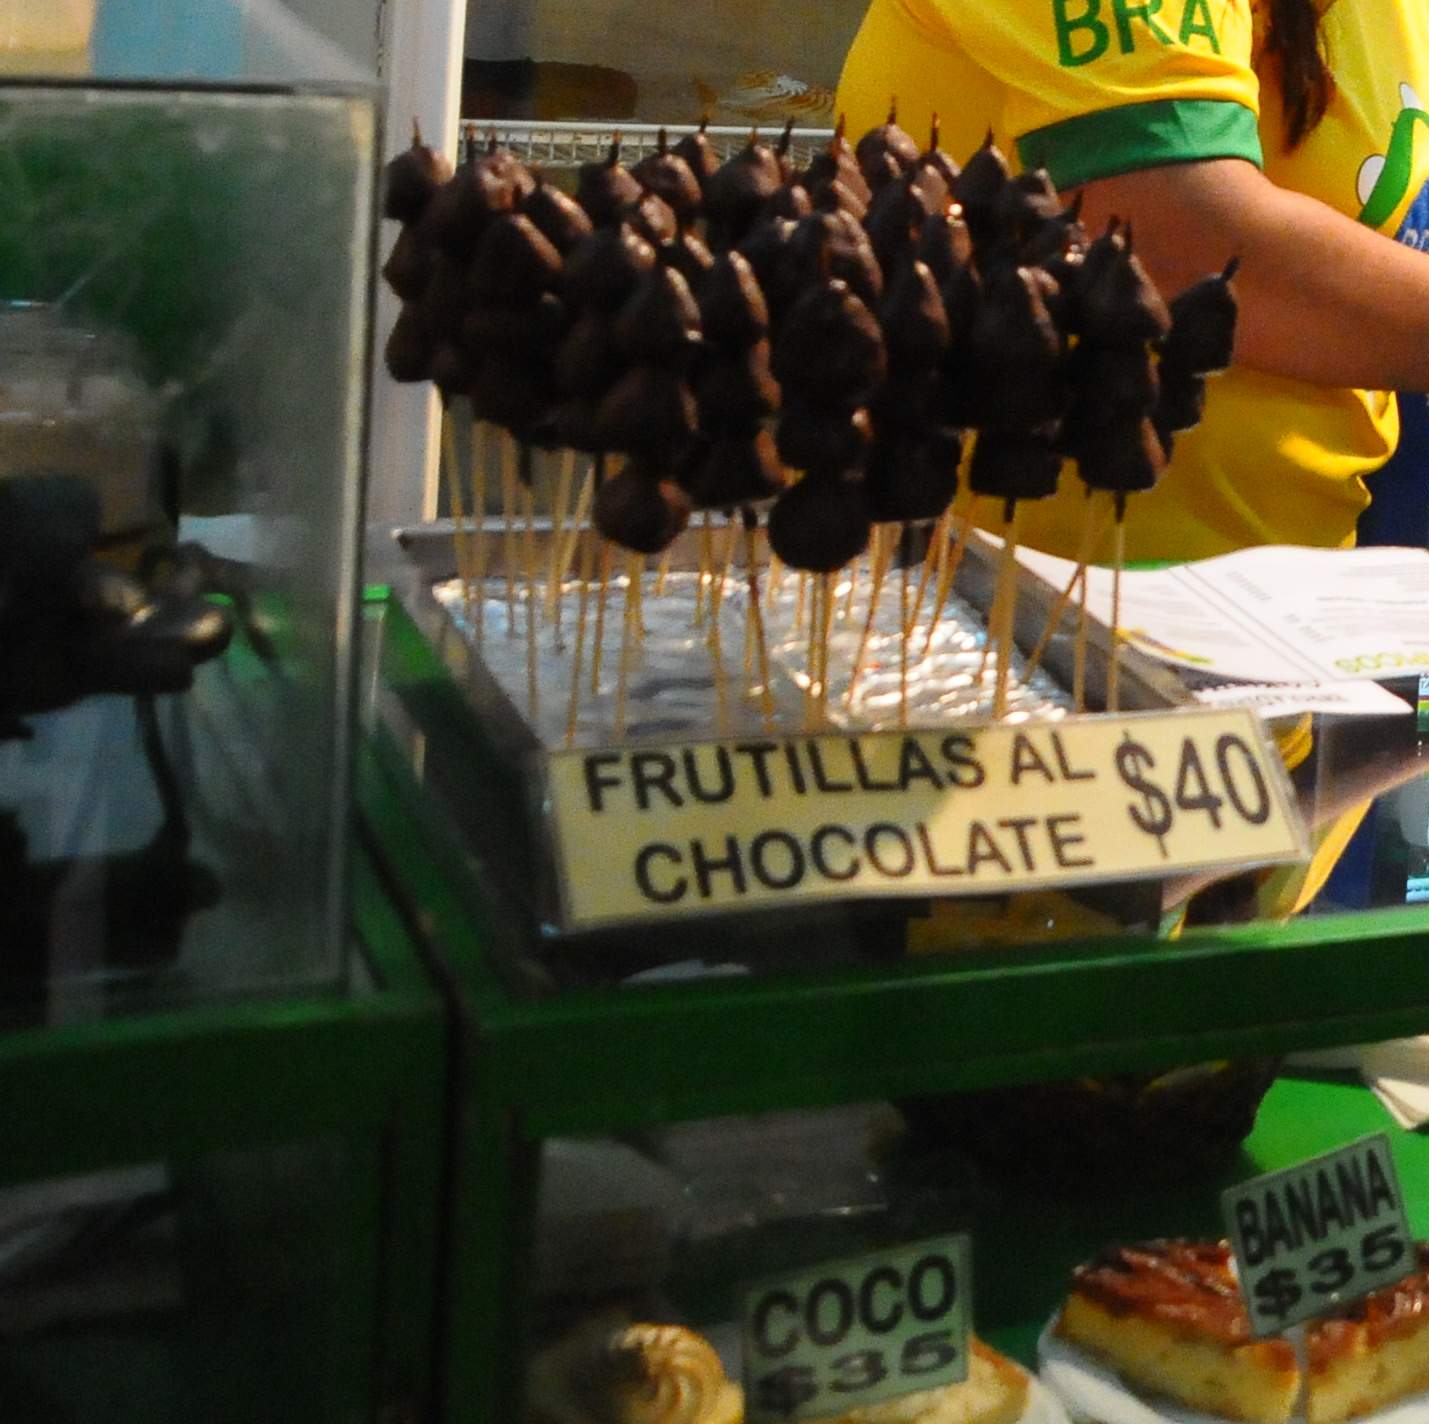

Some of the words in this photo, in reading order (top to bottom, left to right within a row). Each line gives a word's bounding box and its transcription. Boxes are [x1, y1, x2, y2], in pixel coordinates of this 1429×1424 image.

[583, 733, 987, 813] FRUTILLAS
[1009, 730, 1098, 787] AL
[1113, 729, 1272, 859] $40
[634, 814, 1095, 904] CHOCOLATE
[1236, 1148, 1397, 1267] BANANA
[752, 1254, 956, 1359] COCO
[1254, 1224, 1406, 1321] $35
[750, 1329, 957, 1419] $35
